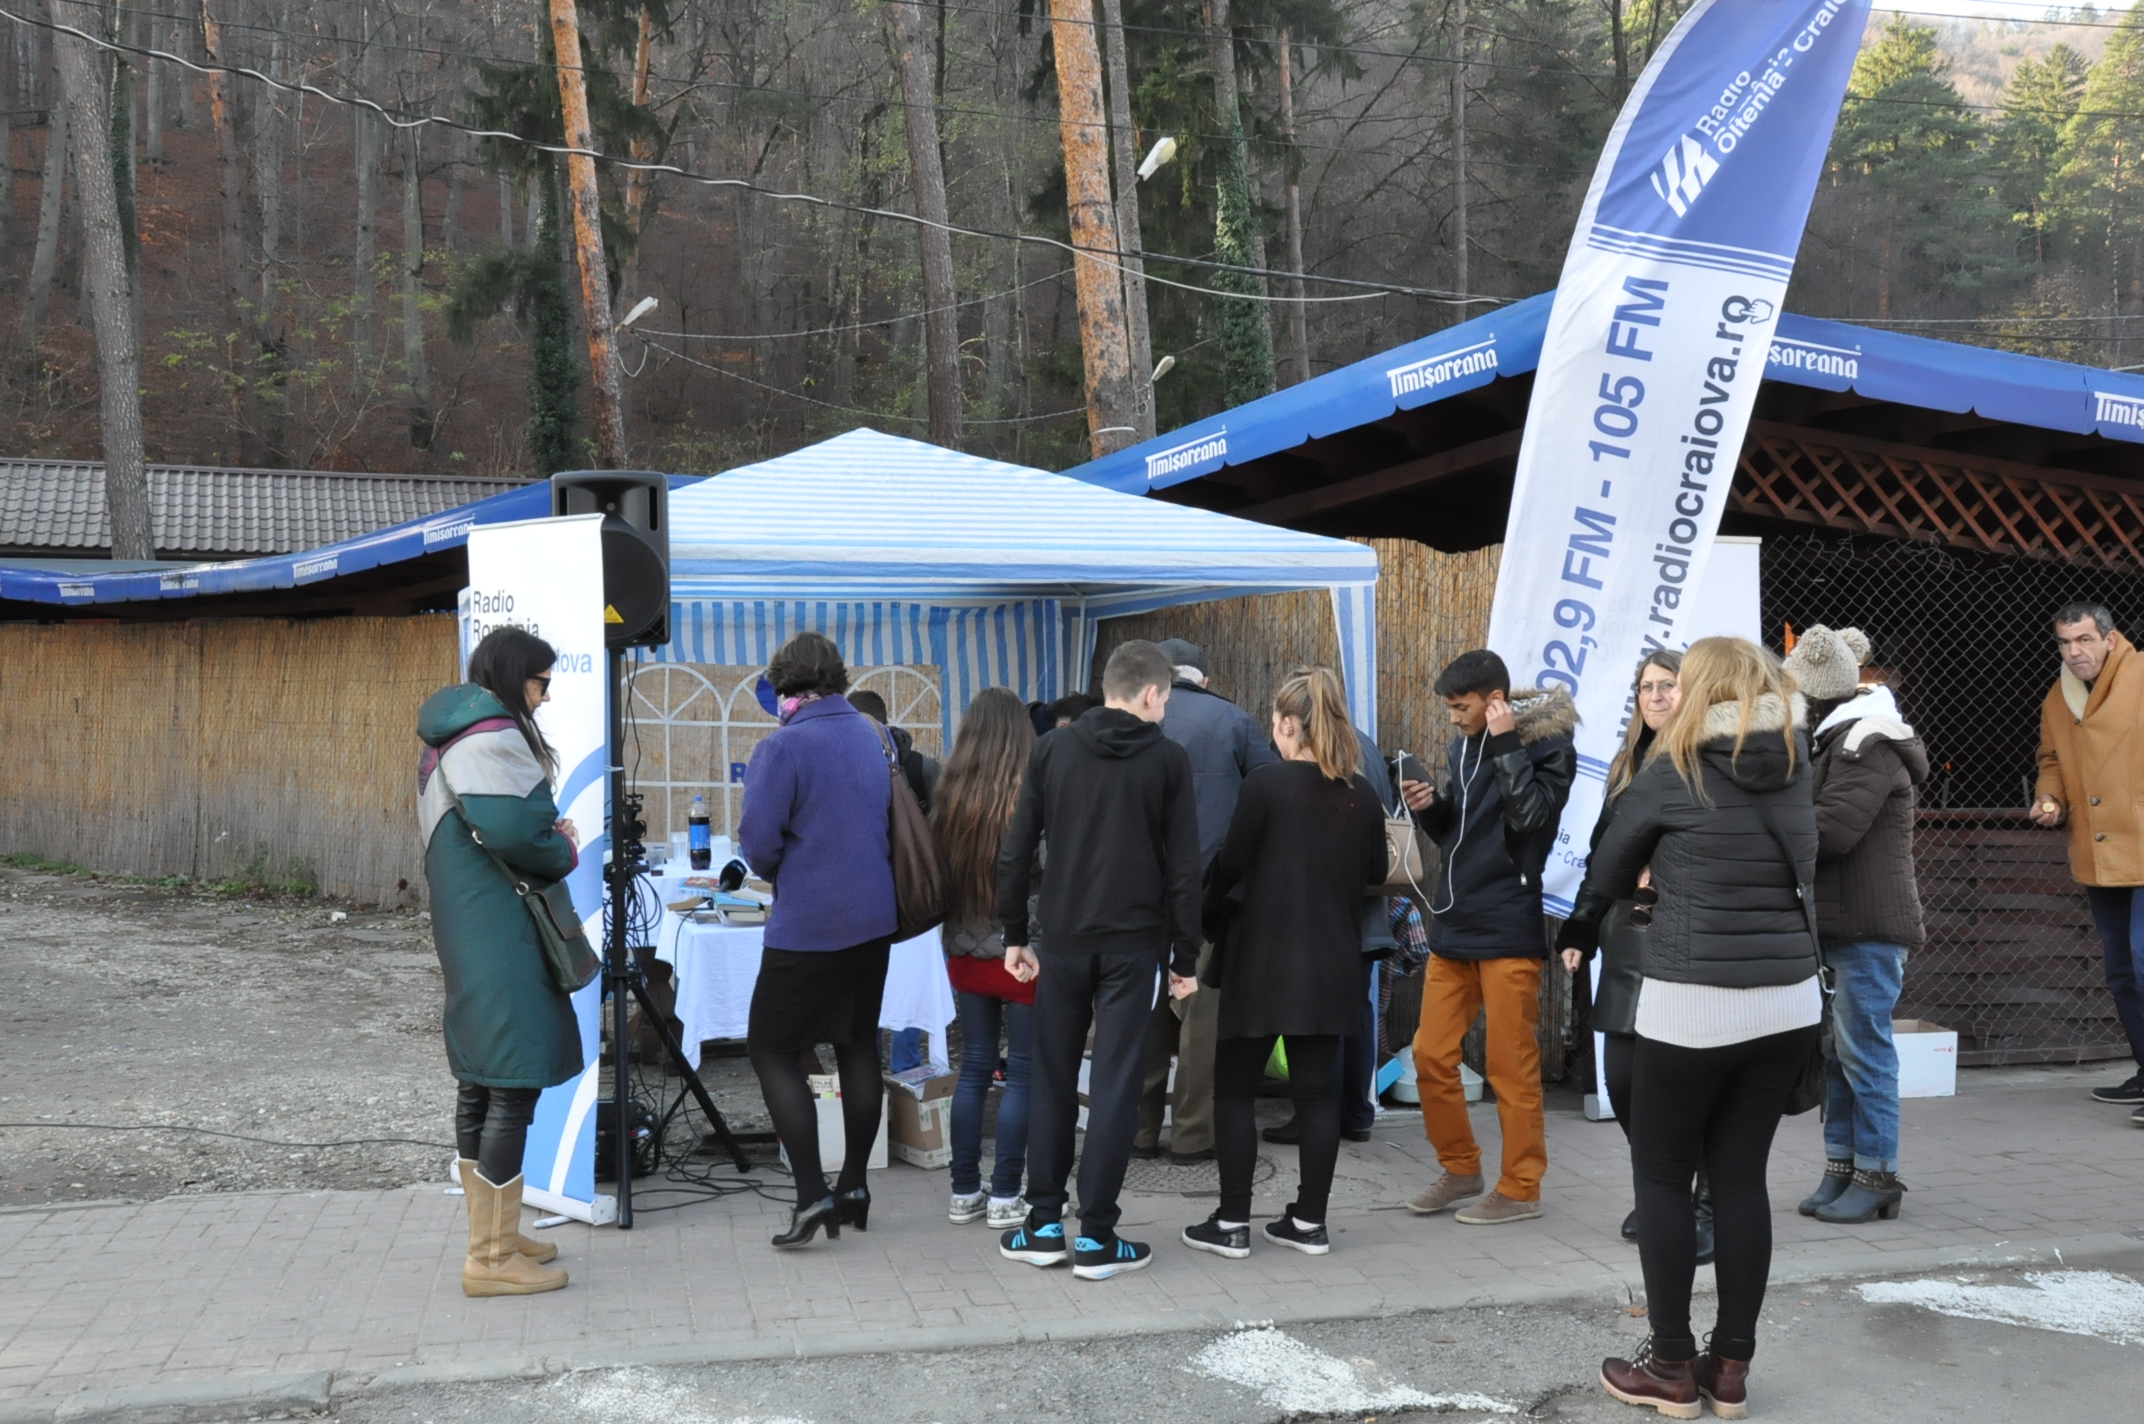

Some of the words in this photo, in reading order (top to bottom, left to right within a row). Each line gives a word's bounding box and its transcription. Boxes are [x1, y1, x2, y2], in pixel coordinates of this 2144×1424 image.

[1694, 70, 1751, 137] Radio
[1717, 71, 1787, 154] Oltenia
[1605, 275, 1669, 362] FM
[1767, 335, 1862, 379] șoreana
[1588, 372, 1646, 462] 105
[1561, 505, 1617, 591] FM
[473, 590, 515, 613] Radio
[473, 617, 540, 642] Roia
[551, 647, 593, 674] iova
